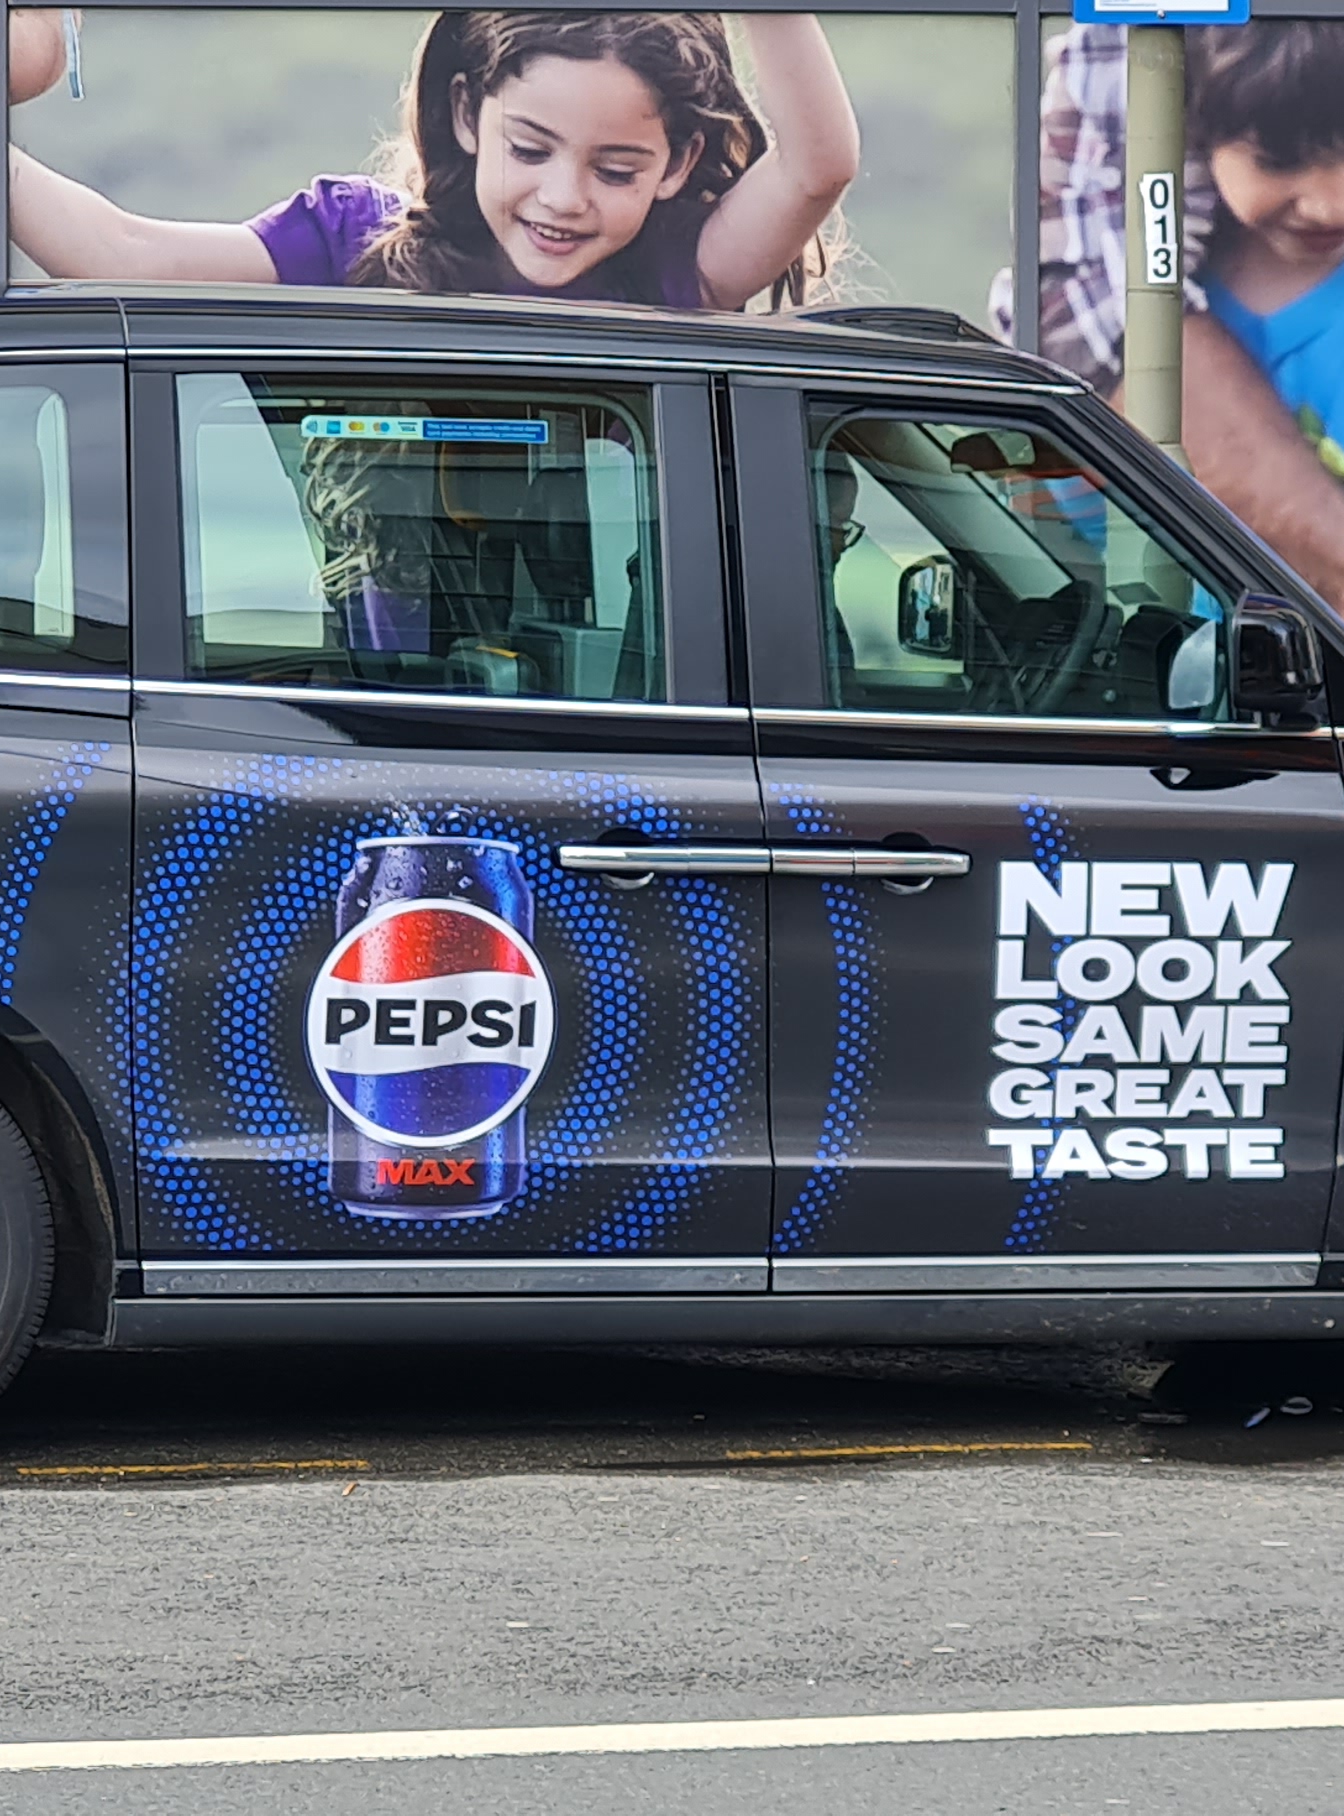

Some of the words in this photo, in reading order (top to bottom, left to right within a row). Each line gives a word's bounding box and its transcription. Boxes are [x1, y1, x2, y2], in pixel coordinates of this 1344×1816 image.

[998, 861, 1295, 937] NEW
[995, 939, 1293, 1001] LOOK
[325, 997, 537, 1048] PEPSI
[992, 1004, 1290, 1064] SAME
[989, 1067, 1286, 1118] GREAT
[377, 1159, 476, 1186] MAX
[987, 1127, 1285, 1180] TASTE
